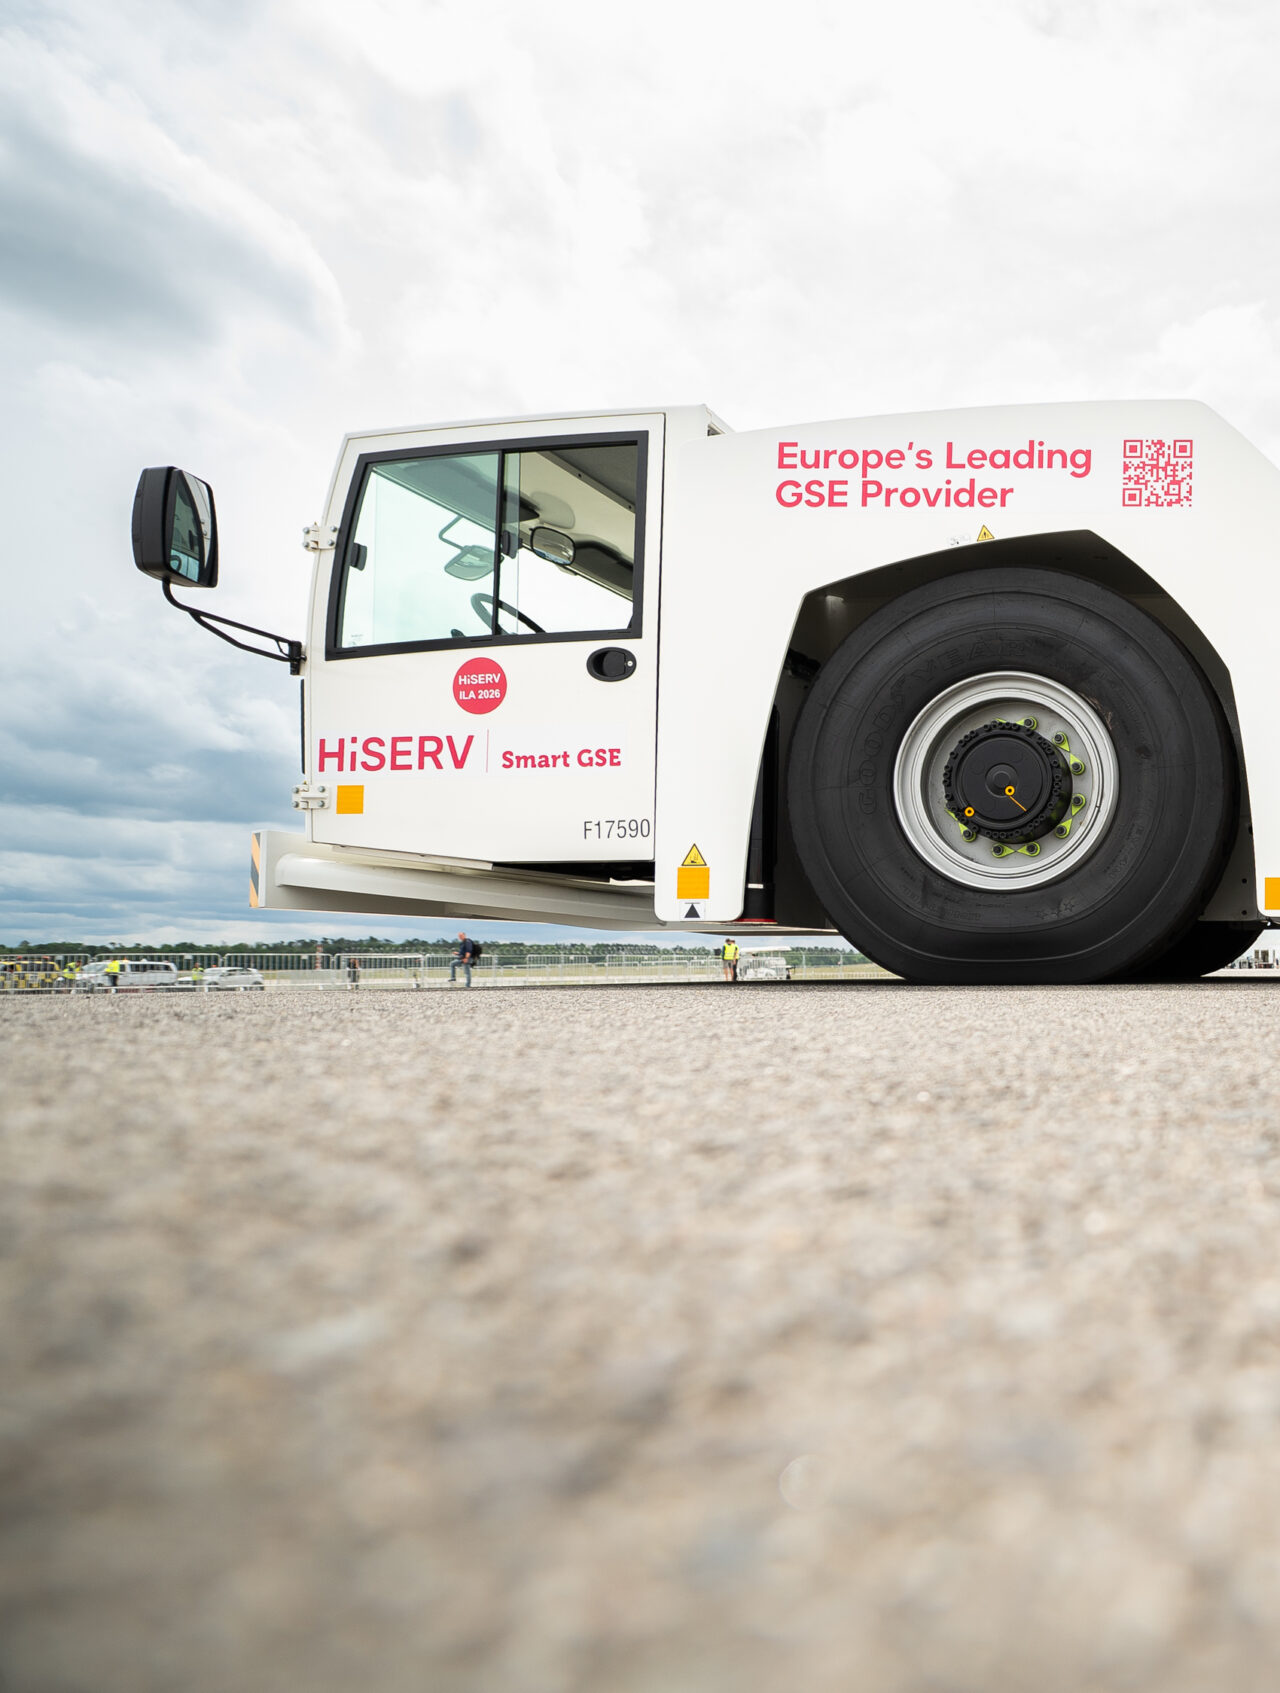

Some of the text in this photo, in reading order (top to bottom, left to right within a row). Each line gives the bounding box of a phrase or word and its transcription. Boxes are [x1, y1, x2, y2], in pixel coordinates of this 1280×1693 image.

[777, 440, 1092, 478] Europe's Leading
[775, 478, 1014, 508] GSE Provider
[458, 673, 501, 685] HiSERV
[459, 689, 501, 700] ILA 2026
[318, 735, 475, 773] HiSERV
[502, 749, 622, 769] Smart GSE
[583, 818, 651, 840] F17590
